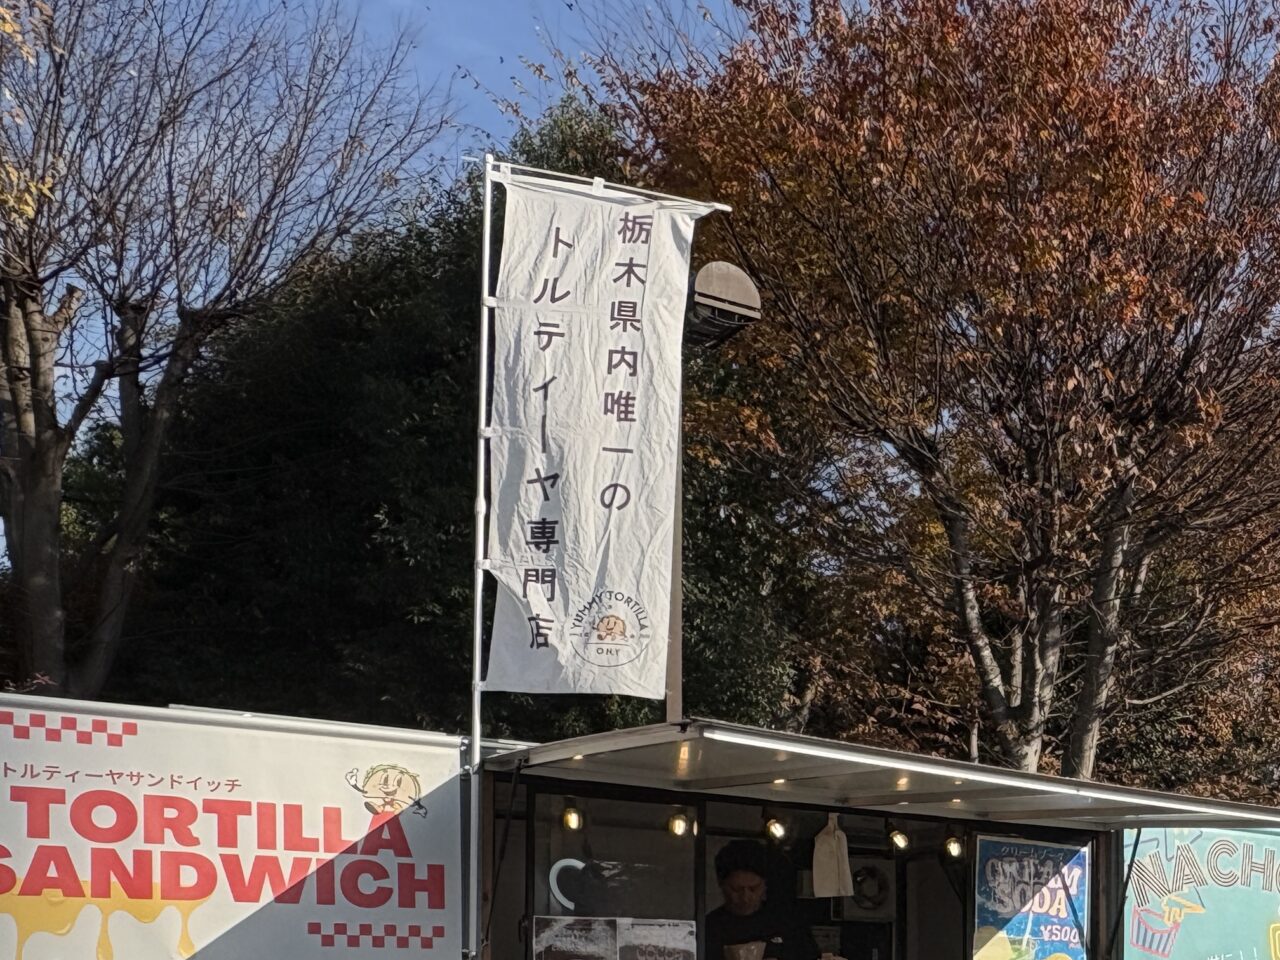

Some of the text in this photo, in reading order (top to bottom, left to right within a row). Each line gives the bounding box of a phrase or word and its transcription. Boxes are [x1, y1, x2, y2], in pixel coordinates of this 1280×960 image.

[600, 211, 653, 511] 栃木県内唯一の
[522, 227, 573, 650] トルティーヤ専門店
[3, 761, 242, 793] トルティーヤサンドイッチ
[9, 785, 413, 858] TORTILLA
[998, 879, 1068, 919] SODA
